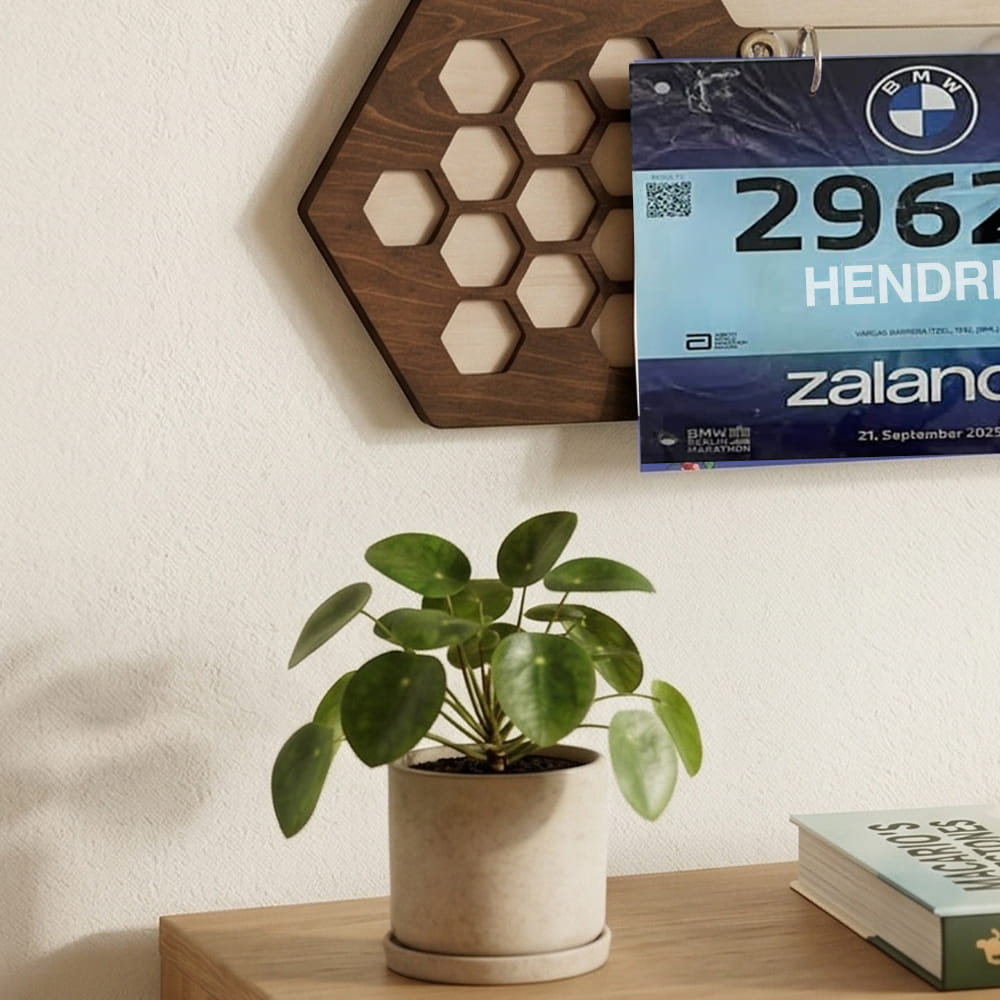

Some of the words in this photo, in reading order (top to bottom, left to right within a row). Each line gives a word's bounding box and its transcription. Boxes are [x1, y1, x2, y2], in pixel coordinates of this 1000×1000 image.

[881, 70, 963, 96] BMW
[687, 428, 726, 440] BMW
[857, 430, 879, 442] 21.
[882, 428, 963, 443] September
[687, 445, 751, 454] MARATHON
